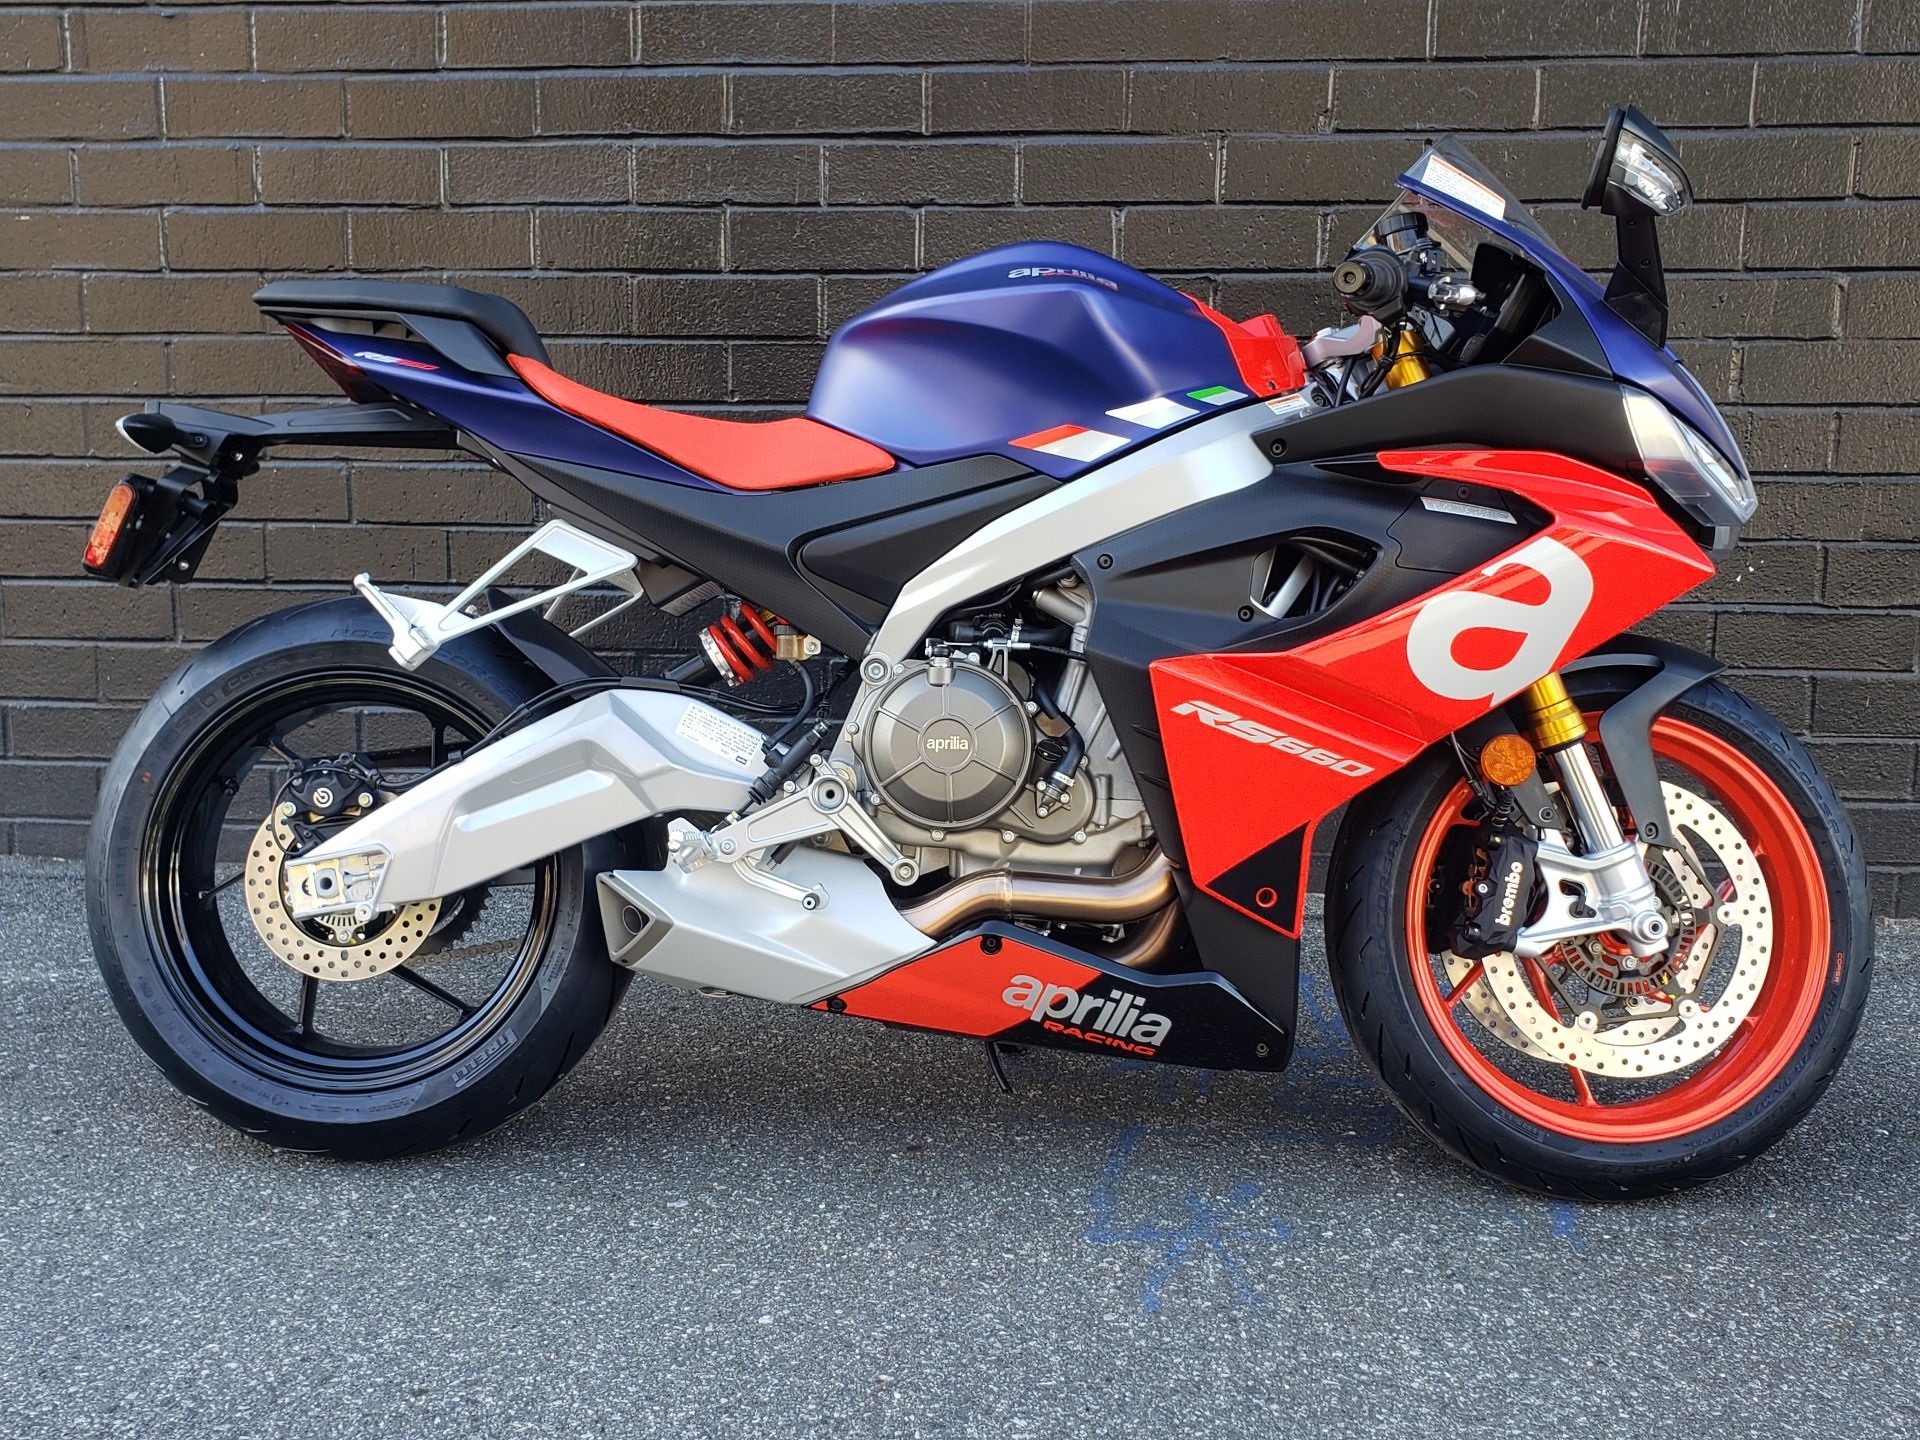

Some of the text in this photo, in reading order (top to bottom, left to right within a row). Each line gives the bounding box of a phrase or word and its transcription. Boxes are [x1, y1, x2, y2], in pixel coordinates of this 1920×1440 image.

[1008, 267, 1119, 292] aprilia
[926, 735, 969, 753] aprilia
[1170, 700, 1375, 777] RS660
[1494, 861, 1523, 926] brembo
[1002, 974, 1172, 1046] aprilia
[1043, 1020, 1156, 1056] RACING
[452, 1028, 519, 1089] PIRELLI
